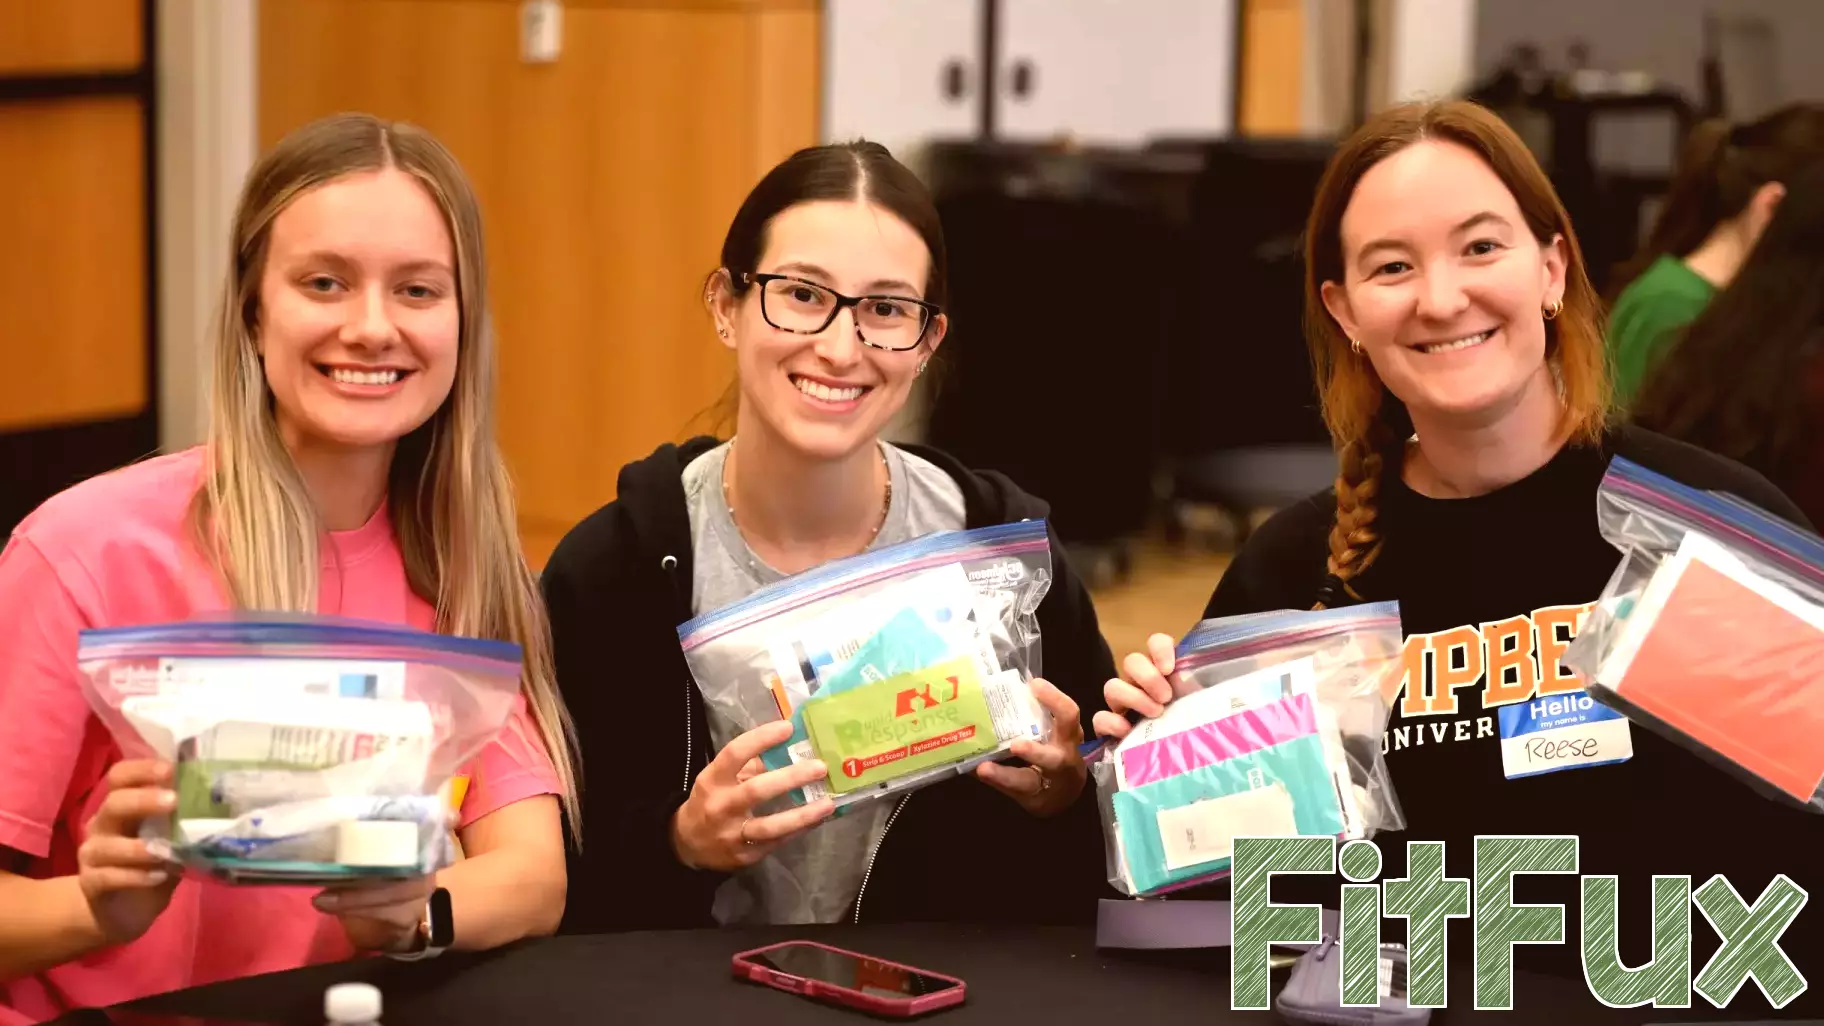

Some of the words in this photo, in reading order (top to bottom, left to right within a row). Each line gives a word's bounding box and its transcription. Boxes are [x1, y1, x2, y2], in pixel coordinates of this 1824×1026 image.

[1530, 695, 1594, 721] Hello
[1540, 720, 1553, 729] my
[1554, 717, 1577, 726] name
[846, 760, 857, 776] 1
[941, 733, 958, 745] Drug
[959, 729, 973, 740] Test
[1525, 737, 1599, 763] Reese
